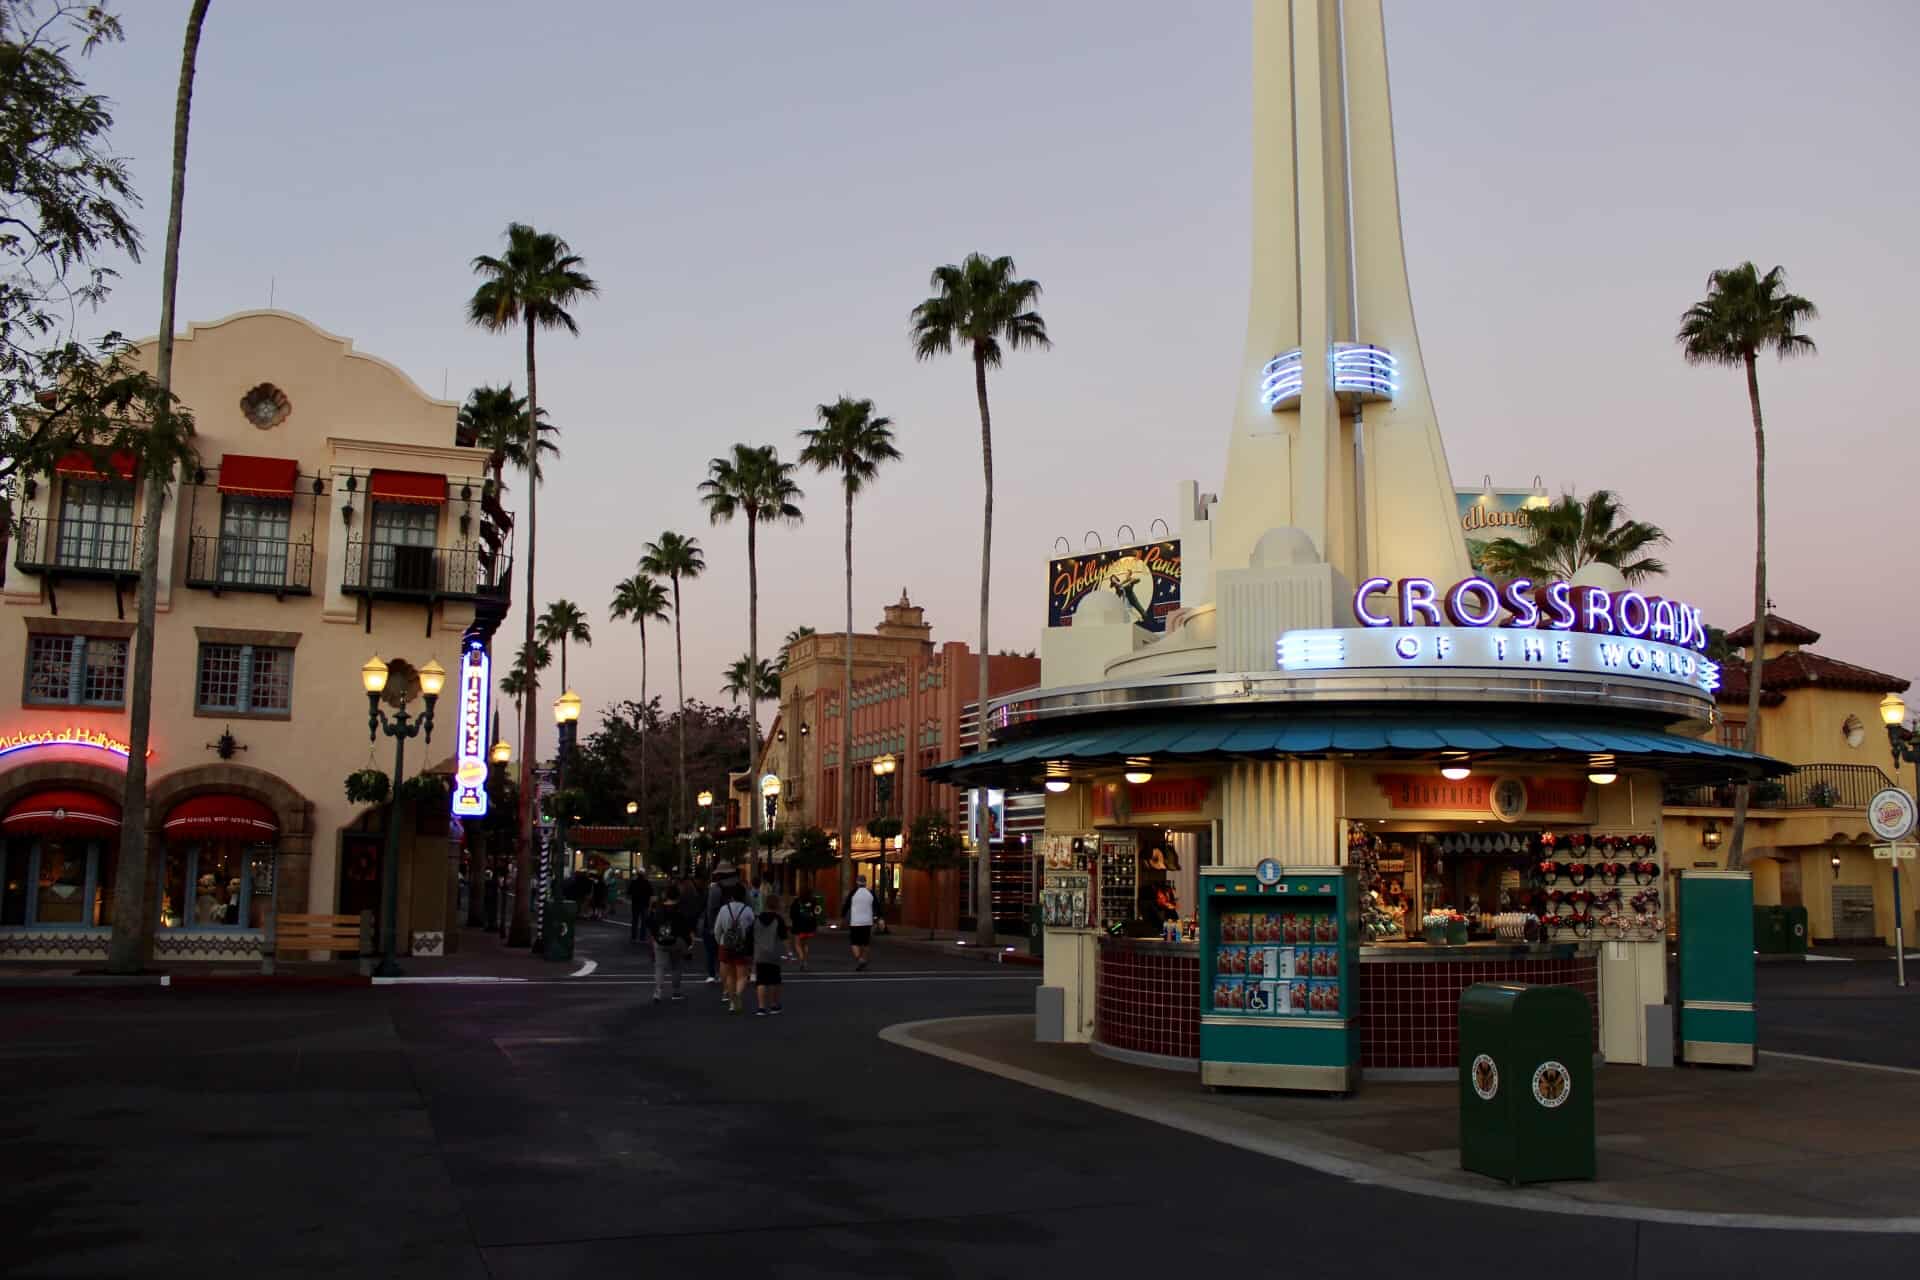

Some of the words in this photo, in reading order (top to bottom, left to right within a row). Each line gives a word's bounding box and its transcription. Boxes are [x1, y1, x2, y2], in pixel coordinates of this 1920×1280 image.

[1353, 576, 1706, 651] CROSSROADS
[1395, 635, 1449, 662] OF
[1494, 636, 1570, 664] THE
[1599, 640, 1697, 677] WORLD
[57, 727, 72, 741] of
